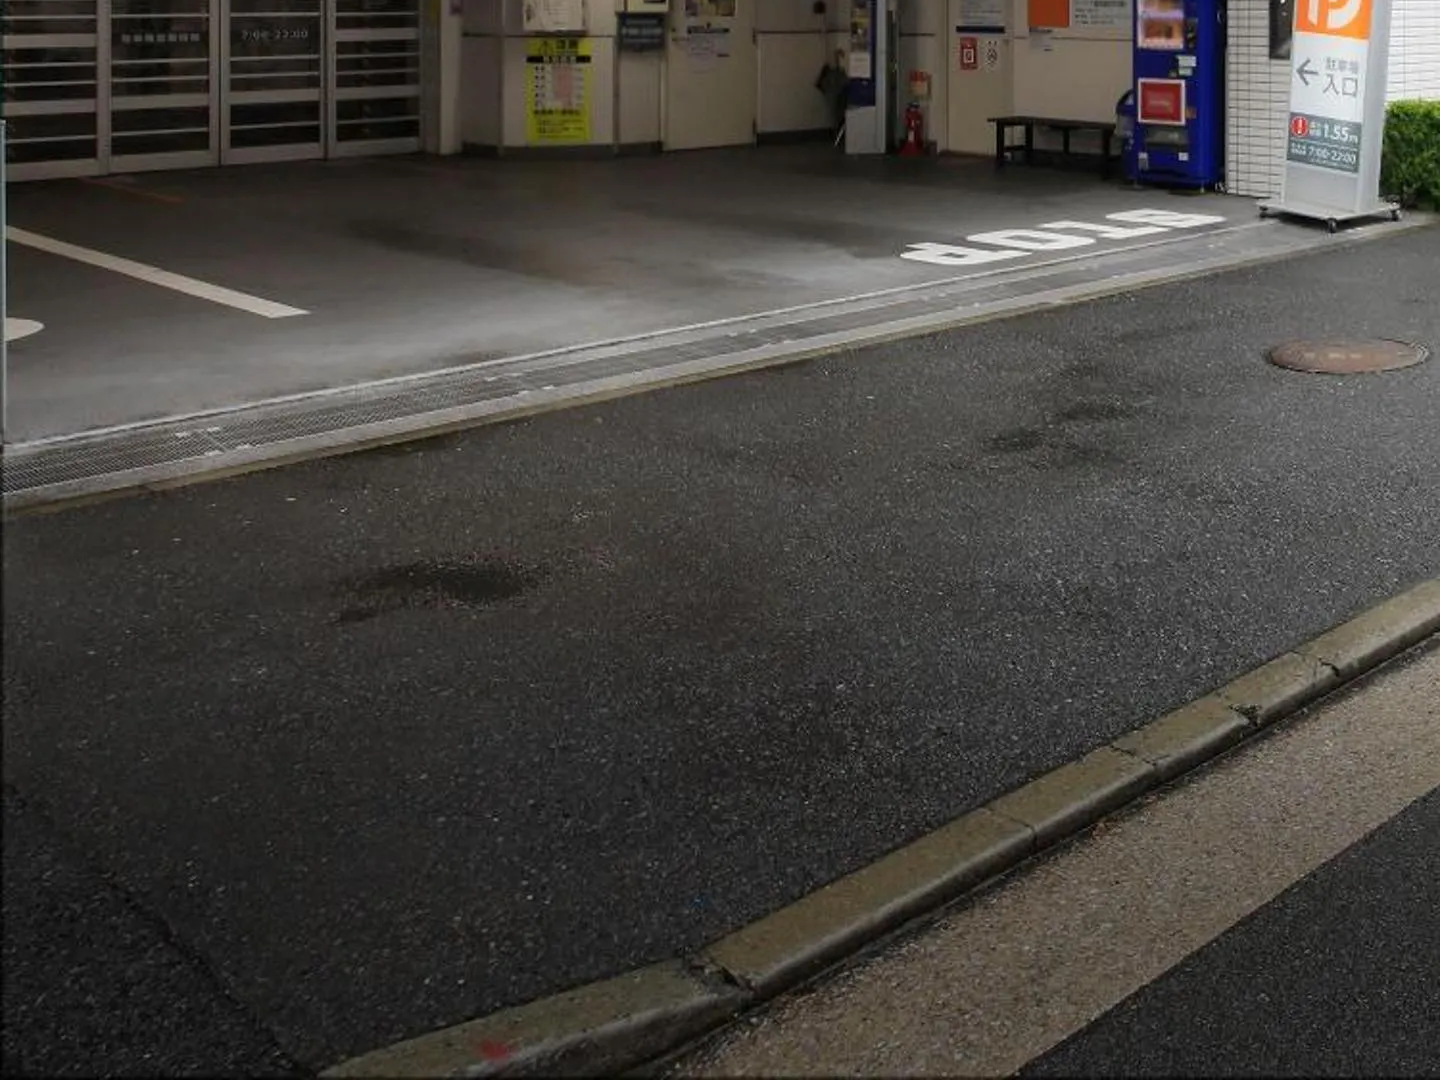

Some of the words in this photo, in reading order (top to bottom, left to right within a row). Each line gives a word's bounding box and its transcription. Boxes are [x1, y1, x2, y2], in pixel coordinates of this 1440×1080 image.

[1321, 73, 1359, 98] 入口
[1322, 122, 1359, 144] 1.55m
[1307, 145, 1357, 165] 7:00-22:00
